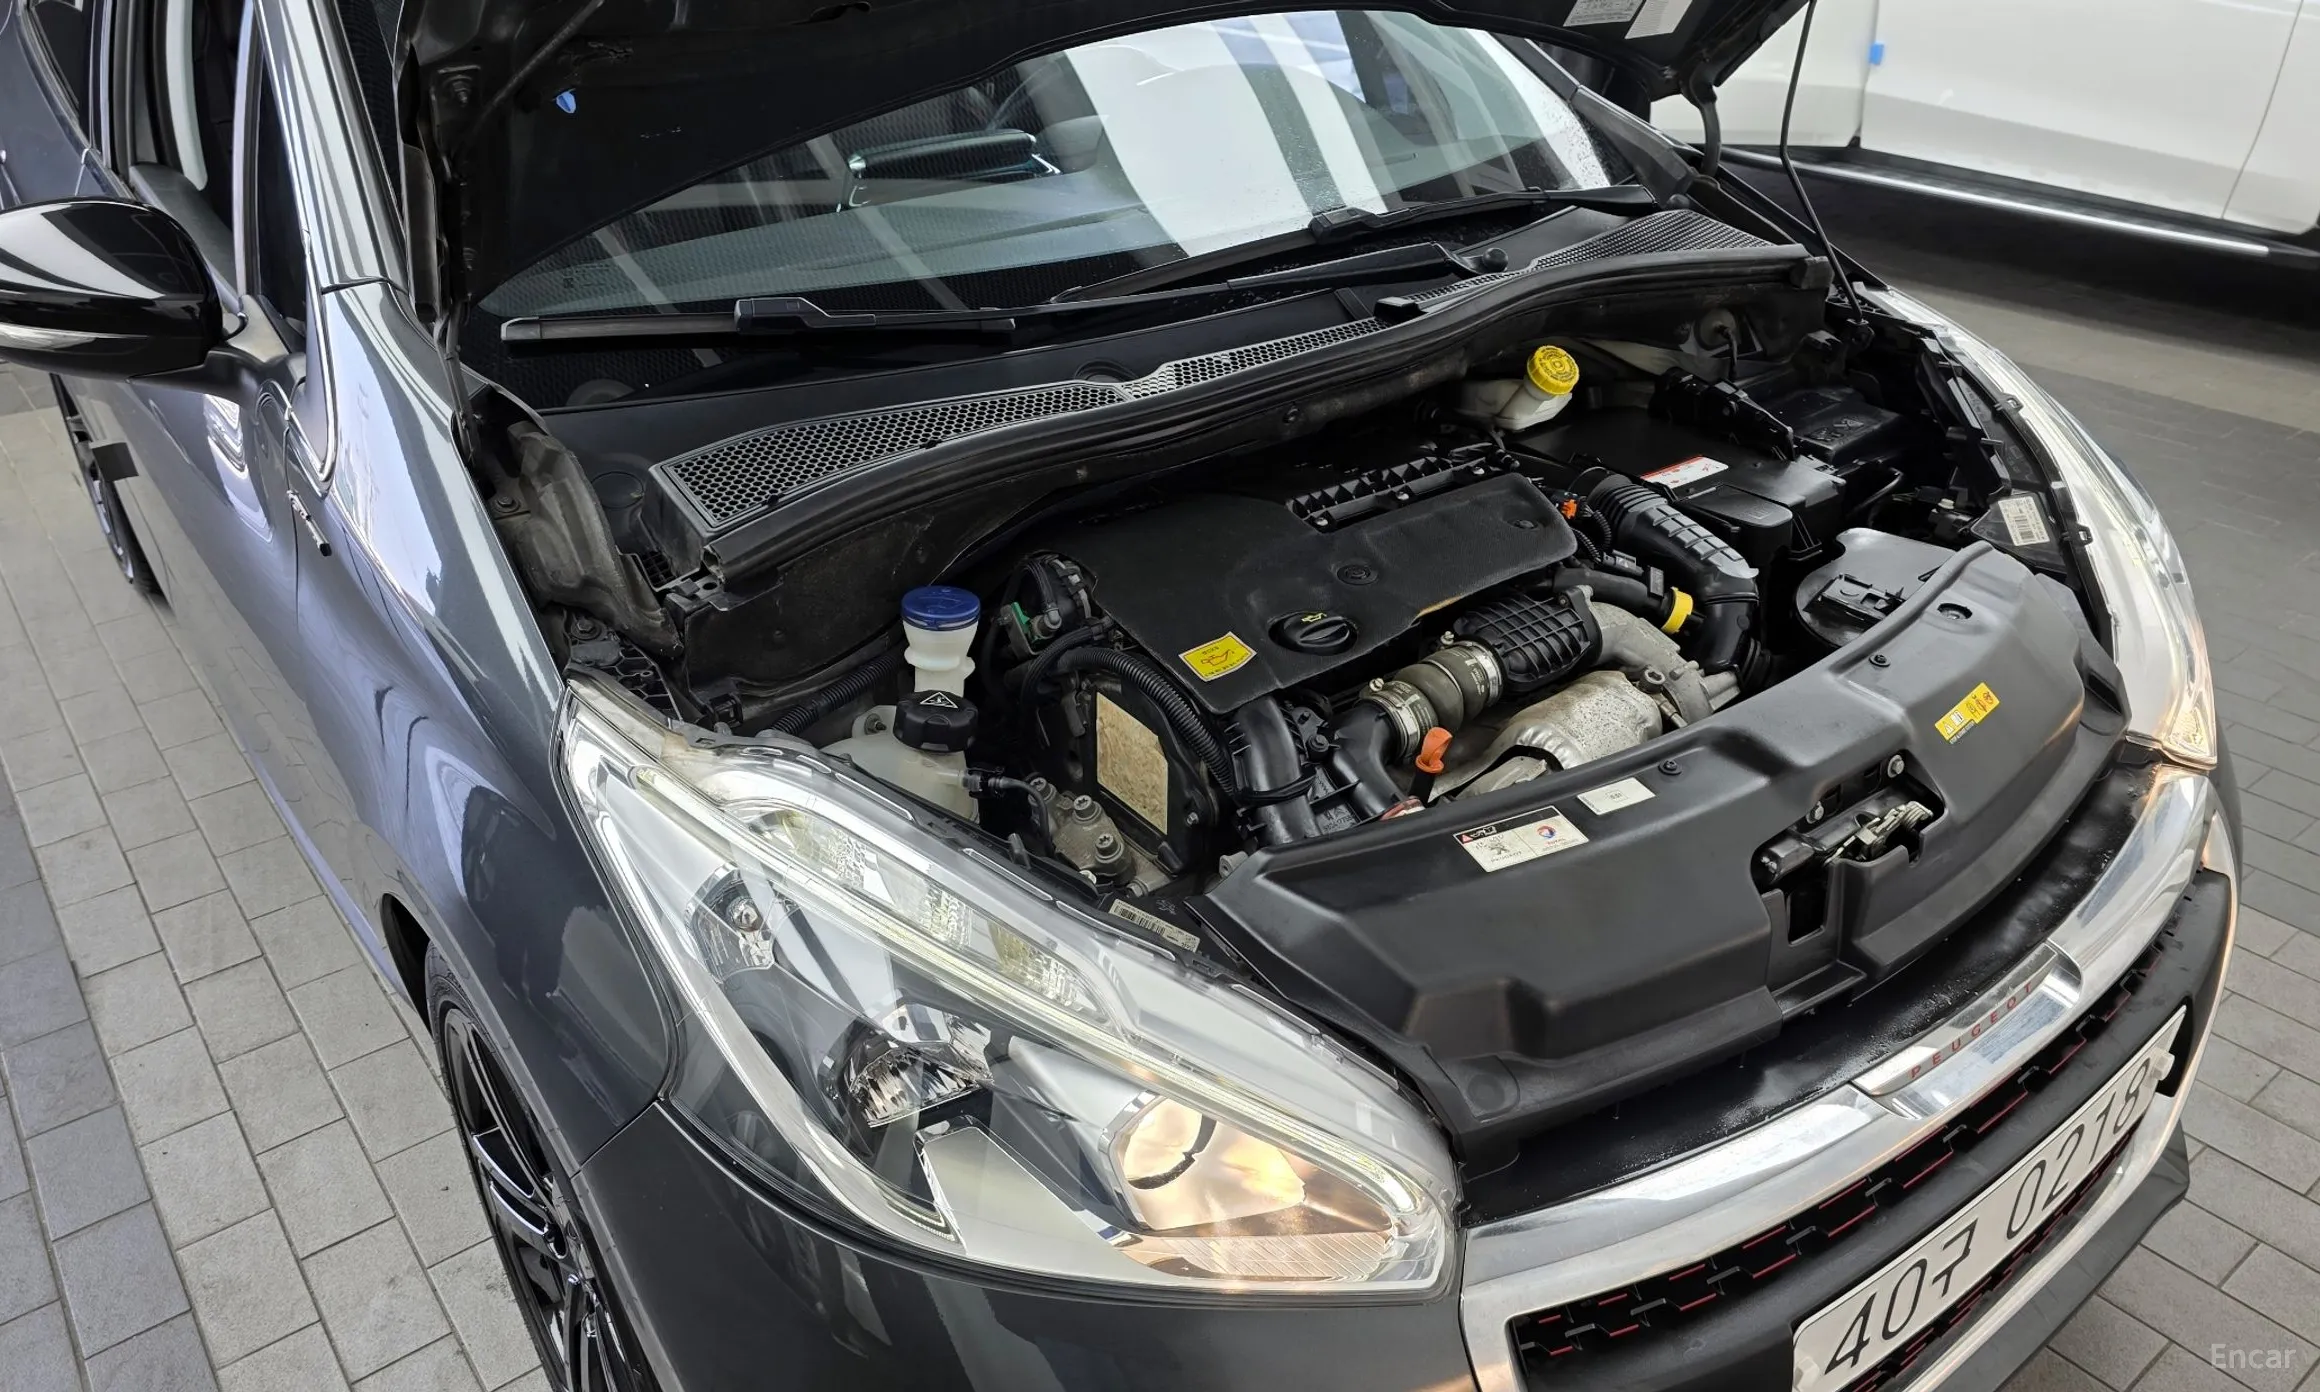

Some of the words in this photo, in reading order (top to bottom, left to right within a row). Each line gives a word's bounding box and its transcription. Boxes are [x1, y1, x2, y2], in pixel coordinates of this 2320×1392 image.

[1909, 981, 2032, 1079] PEUGEOT
[1824, 1217, 1978, 1375] 40구
[2006, 1057, 2151, 1241] 0218
